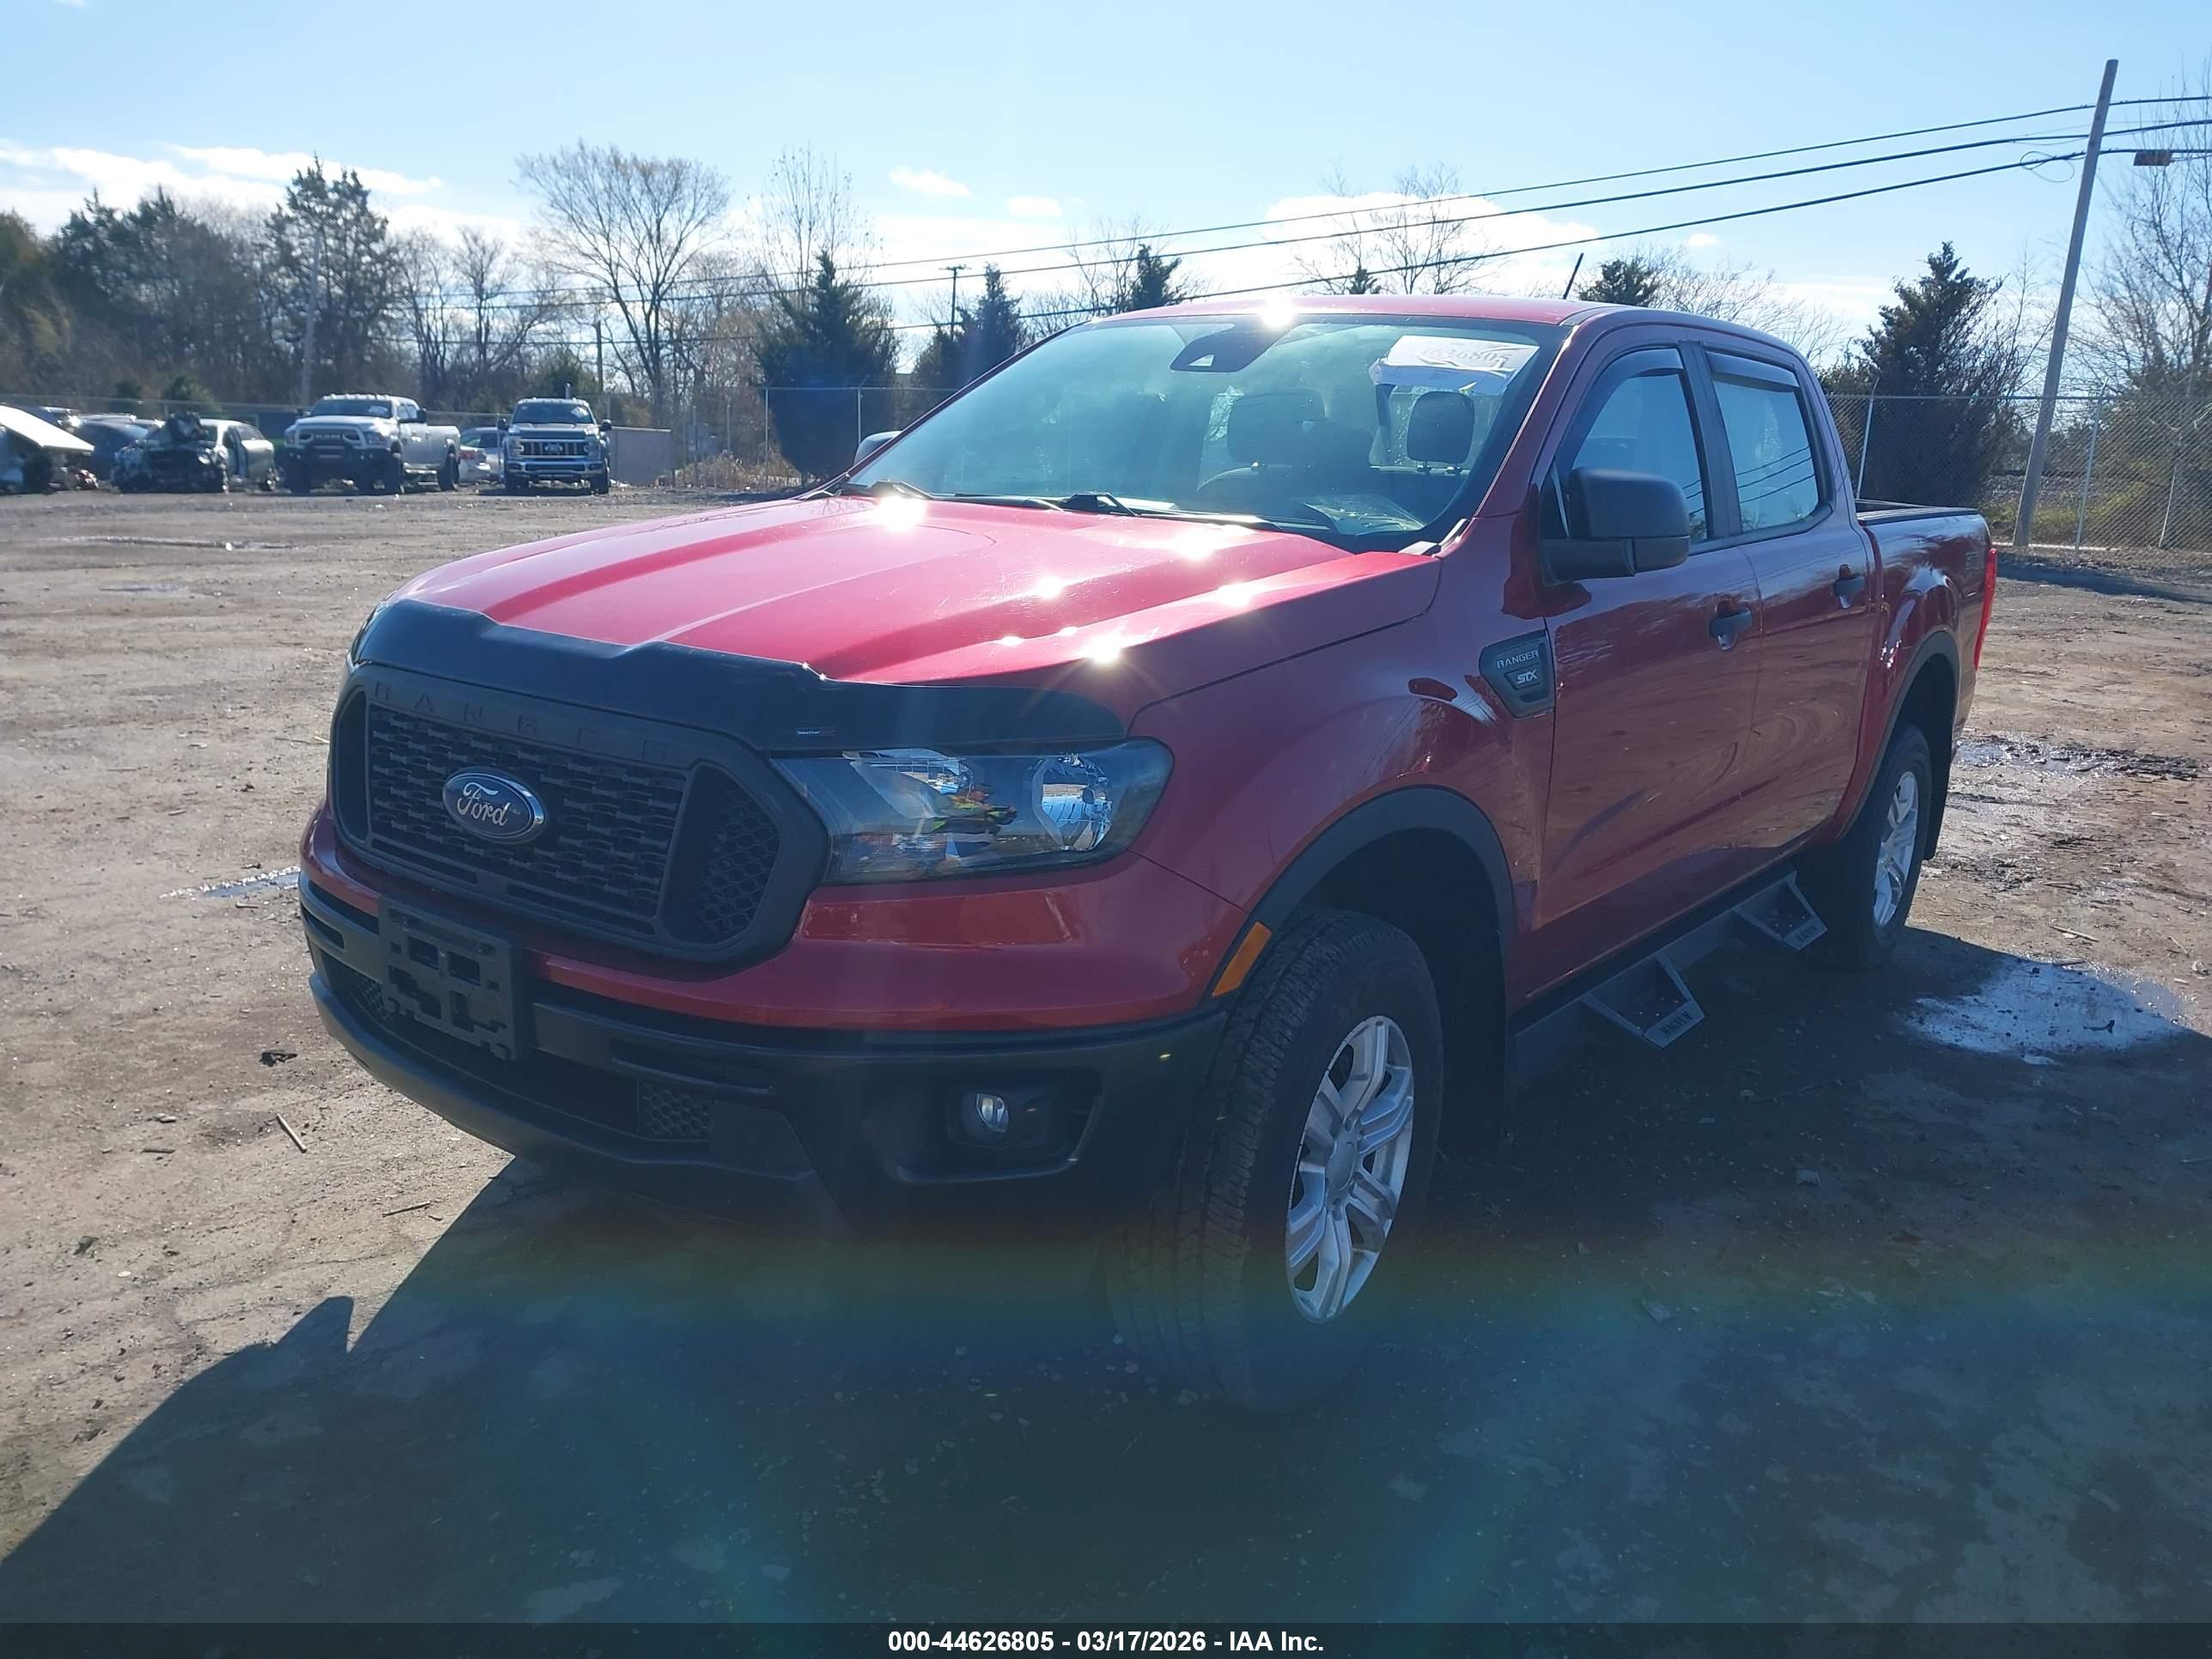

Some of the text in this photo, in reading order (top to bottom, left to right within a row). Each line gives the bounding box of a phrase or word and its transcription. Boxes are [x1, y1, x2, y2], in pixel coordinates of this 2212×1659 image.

[1497, 650, 1539, 669] RANGER
[1516, 670, 1538, 684] STX
[457, 781, 511, 826] Ford
